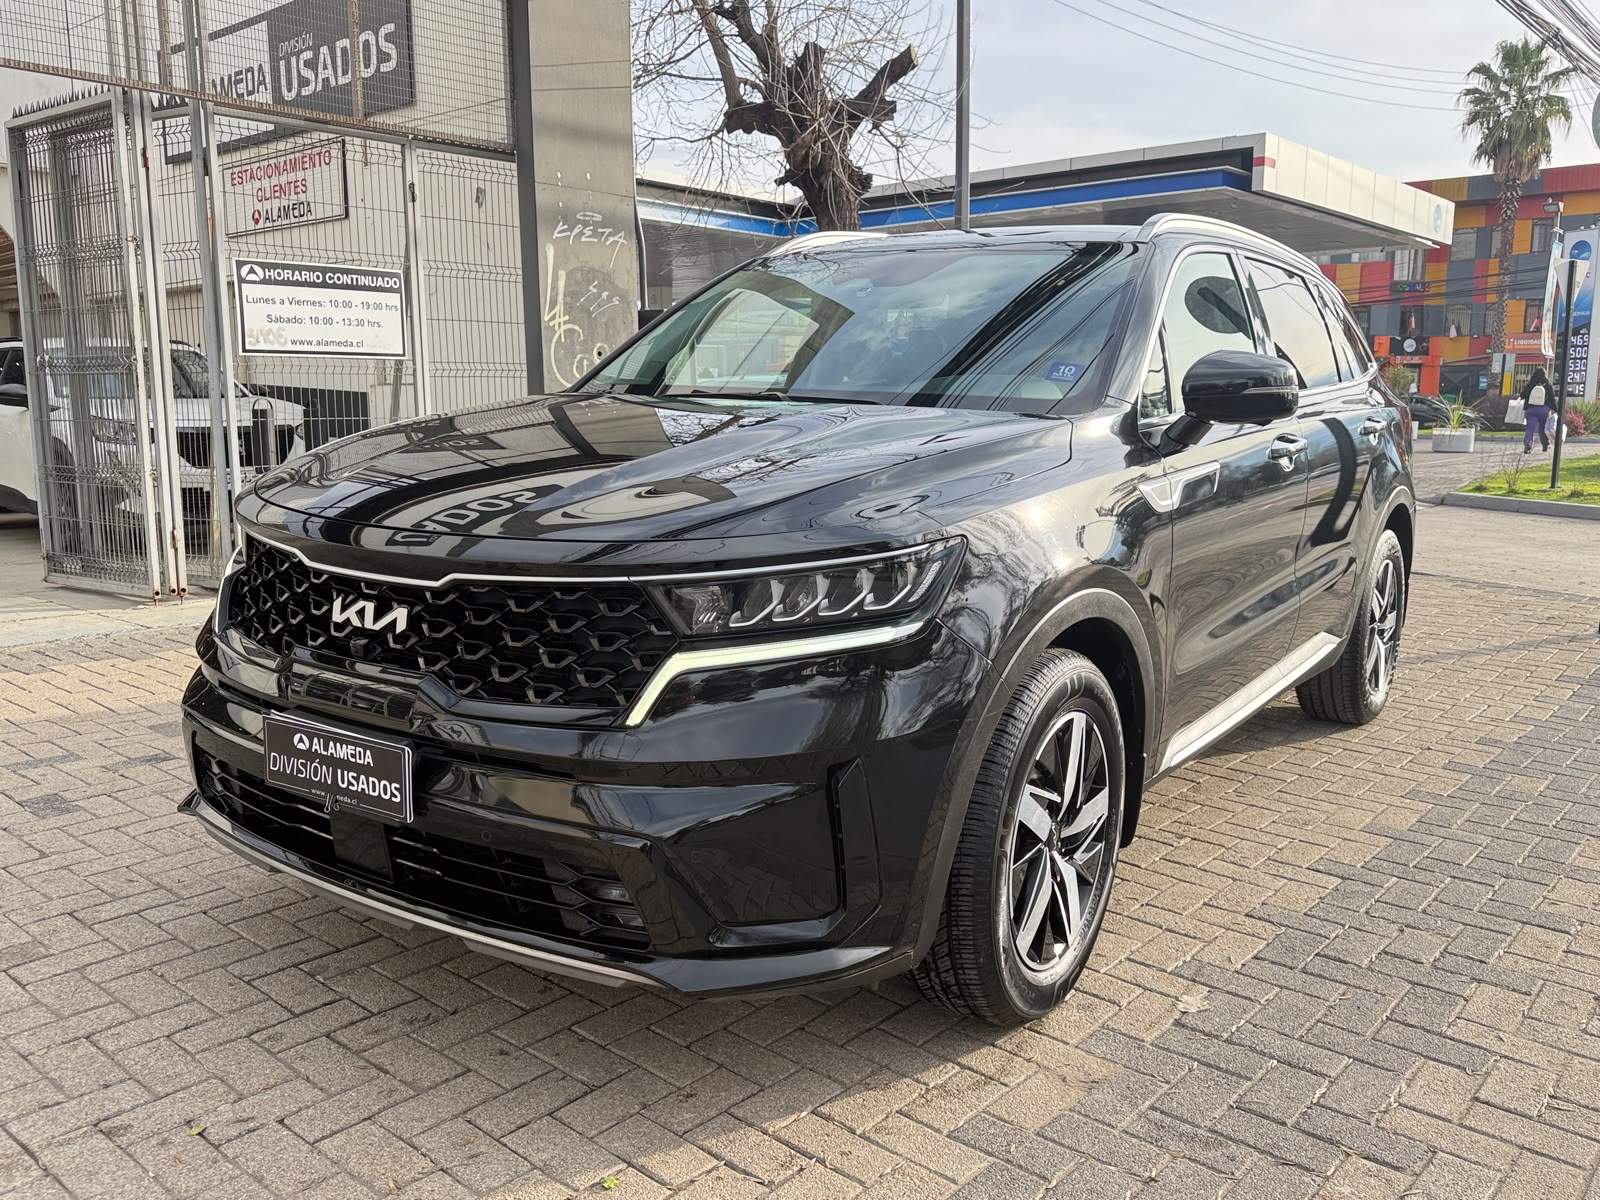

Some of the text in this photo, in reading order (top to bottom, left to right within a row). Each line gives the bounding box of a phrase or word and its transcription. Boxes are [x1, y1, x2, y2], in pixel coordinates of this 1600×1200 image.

[279, 31, 313, 57] DIVISIÓN
[279, 22, 398, 101] USADOS
[230, 149, 332, 187] ESTACIONAMIENTO
[256, 178, 308, 202] CLIENTES
[264, 200, 313, 224] ALAMEDA
[265, 268, 400, 289] HORARIO CONTINUADO
[245, 295, 276, 305] Lunes
[287, 296, 326, 308] Viernes:
[328, 299, 353, 309] 10:00
[360, 301, 383, 311] 19:00
[385, 302, 399, 312] hrs
[266, 313, 306, 325] Sábado:
[308, 316, 334, 326] 10:00
[342, 317, 365, 327] 13:30
[367, 319, 384, 328] hrs.
[290, 337, 364, 348] www.alameda.cl
[1571, 334, 1589, 346] 469
[1569, 347, 1588, 358] 500
[1058, 365, 1076, 375] 10
[1568, 359, 1587, 370] 530
[332, 595, 409, 635] KIA
[311, 736, 374, 767] ALAMEDA
[270, 752, 401, 803] DIVISIÓN USADOS
